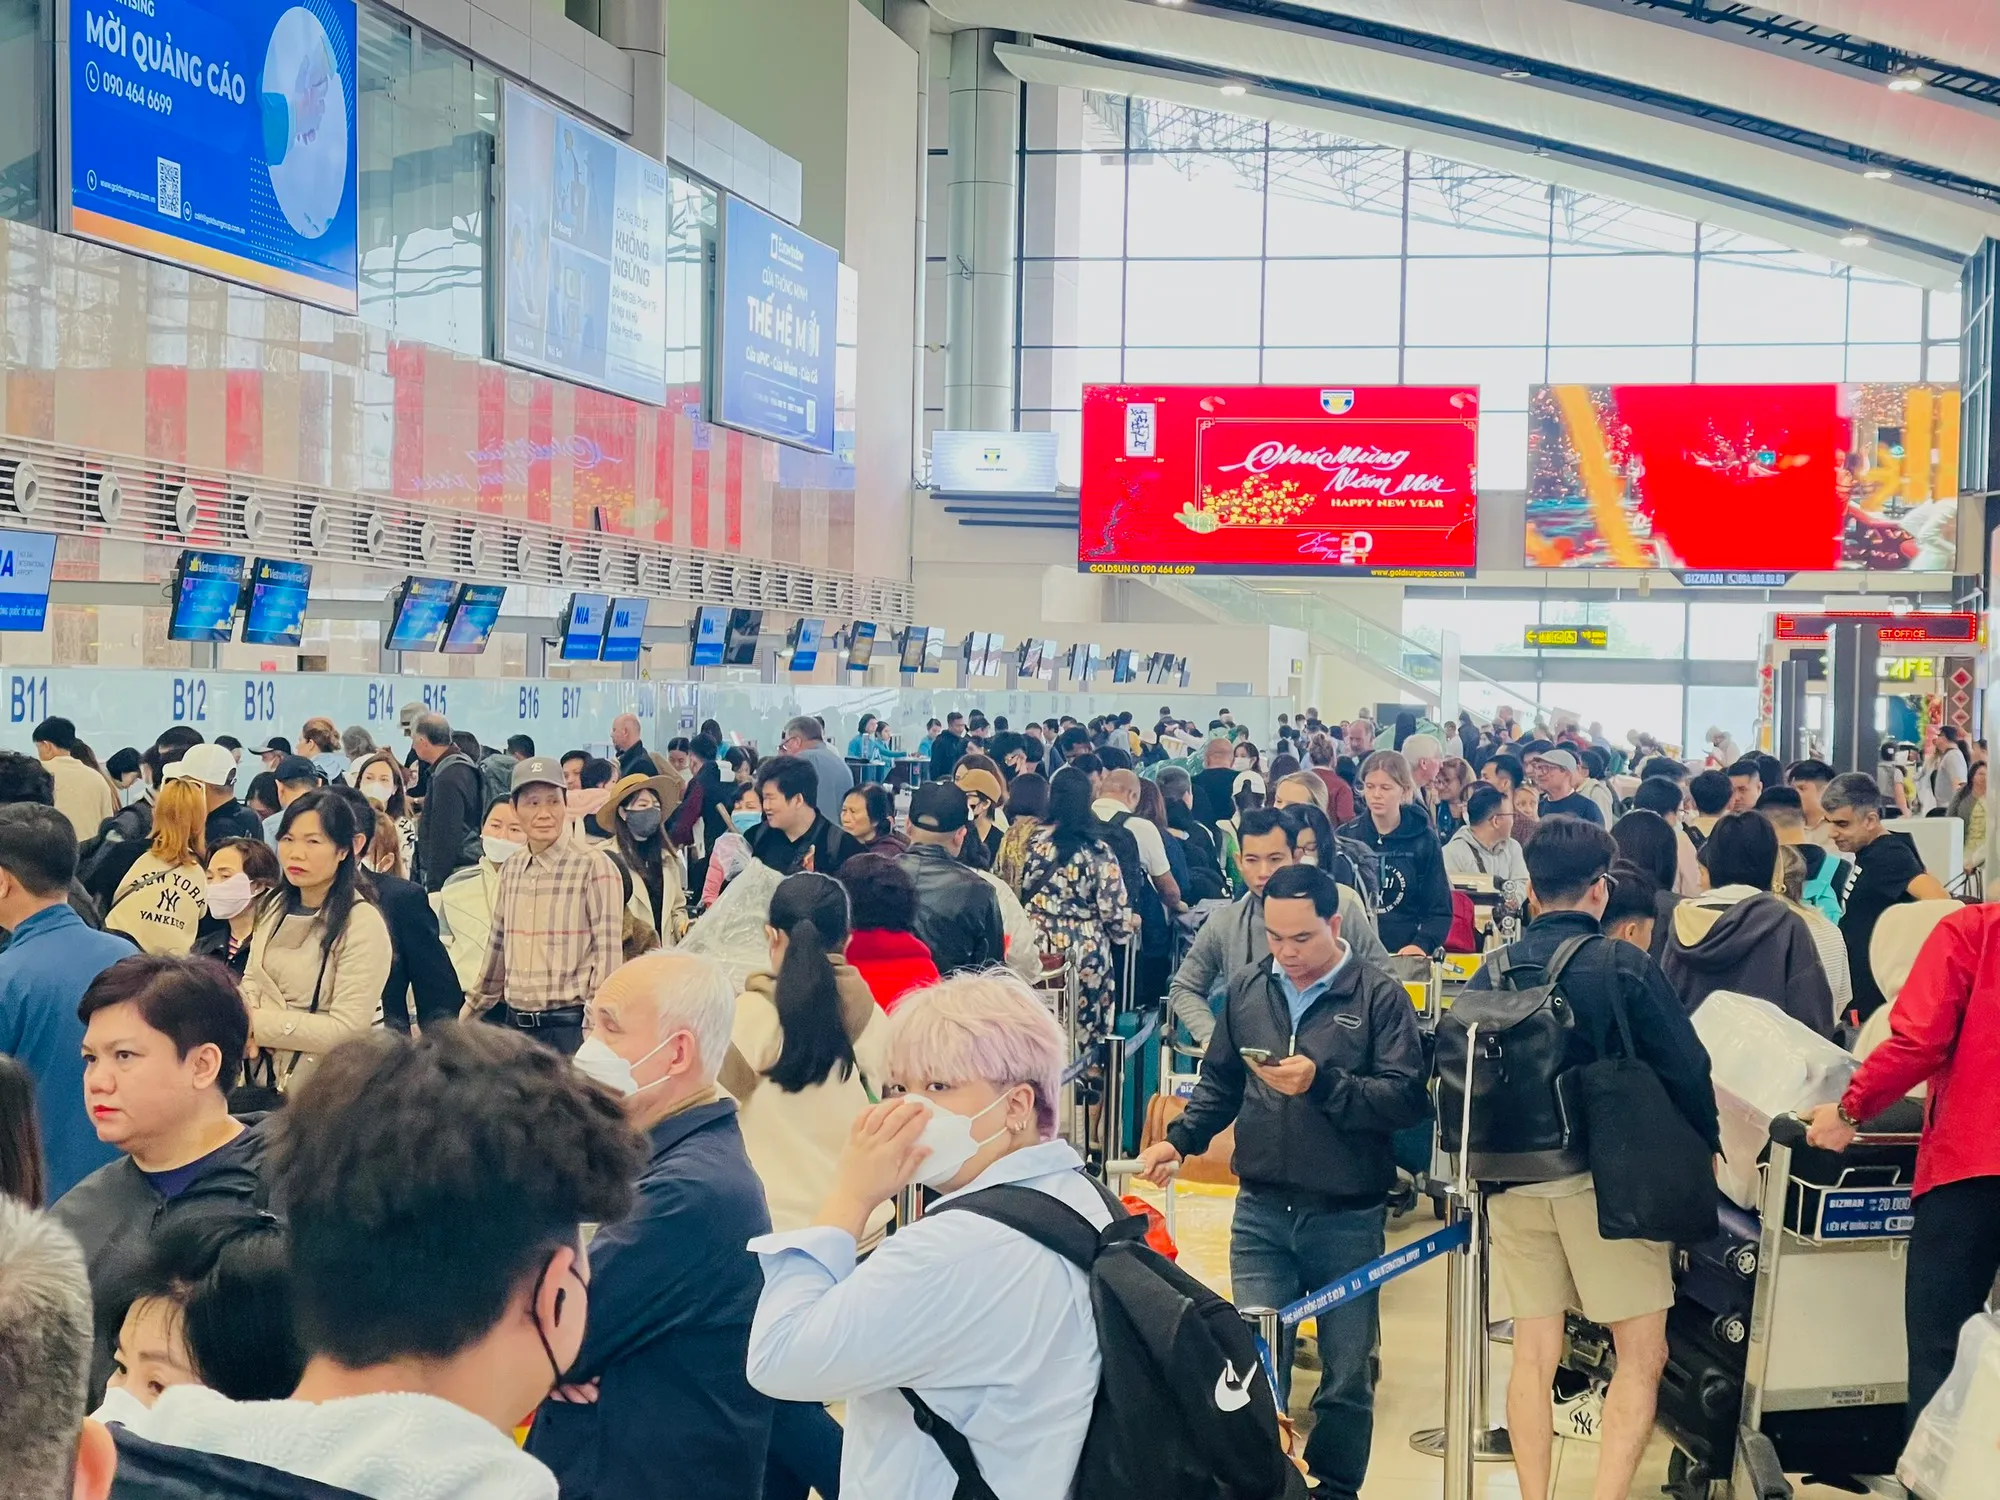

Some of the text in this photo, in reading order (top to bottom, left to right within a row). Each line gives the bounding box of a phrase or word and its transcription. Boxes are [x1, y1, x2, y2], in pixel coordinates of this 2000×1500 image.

[86, 10, 245, 105] MỜI QUẢNG CÁO
[103, 72, 172, 115] 090 464 6699
[615, 230, 649, 261] KHÔNG
[613, 256, 650, 287] NGỪNG
[747, 293, 819, 357] THẾ HỆ MỚI
[1218, 441, 1410, 473] Chúc Mừng
[1323, 466, 1456, 496] Năm Mới
[1331, 499, 1444, 508] HAPPY NEW YEAR
[1089, 564, 1195, 574] GOLDSUN 090 464 6699
[1370, 569, 1465, 578] www.goldsungroup.com.vn
[1684, 573, 1724, 584] BIZMAN
[574, 606, 589, 624] NIA
[614, 611, 629, 628] NIA
[1894, 629, 1926, 638] OFFICE
[1876, 657, 1934, 679] CAFE
[11, 676, 48, 722] B11
[173, 679, 206, 720] B12
[245, 680, 274, 720] B13
[368, 684, 393, 720] B14
[423, 684, 447, 716] B15
[519, 687, 539, 719] B16
[562, 687, 581, 718] B17
[173, 873, 205, 908] YORK
[140, 910, 185, 930] YANKEES
[1829, 1199, 1865, 1209] BIZMAN
[1826, 1221, 1840, 1232] LIÊN
[1573, 1411, 1593, 1436] NY
